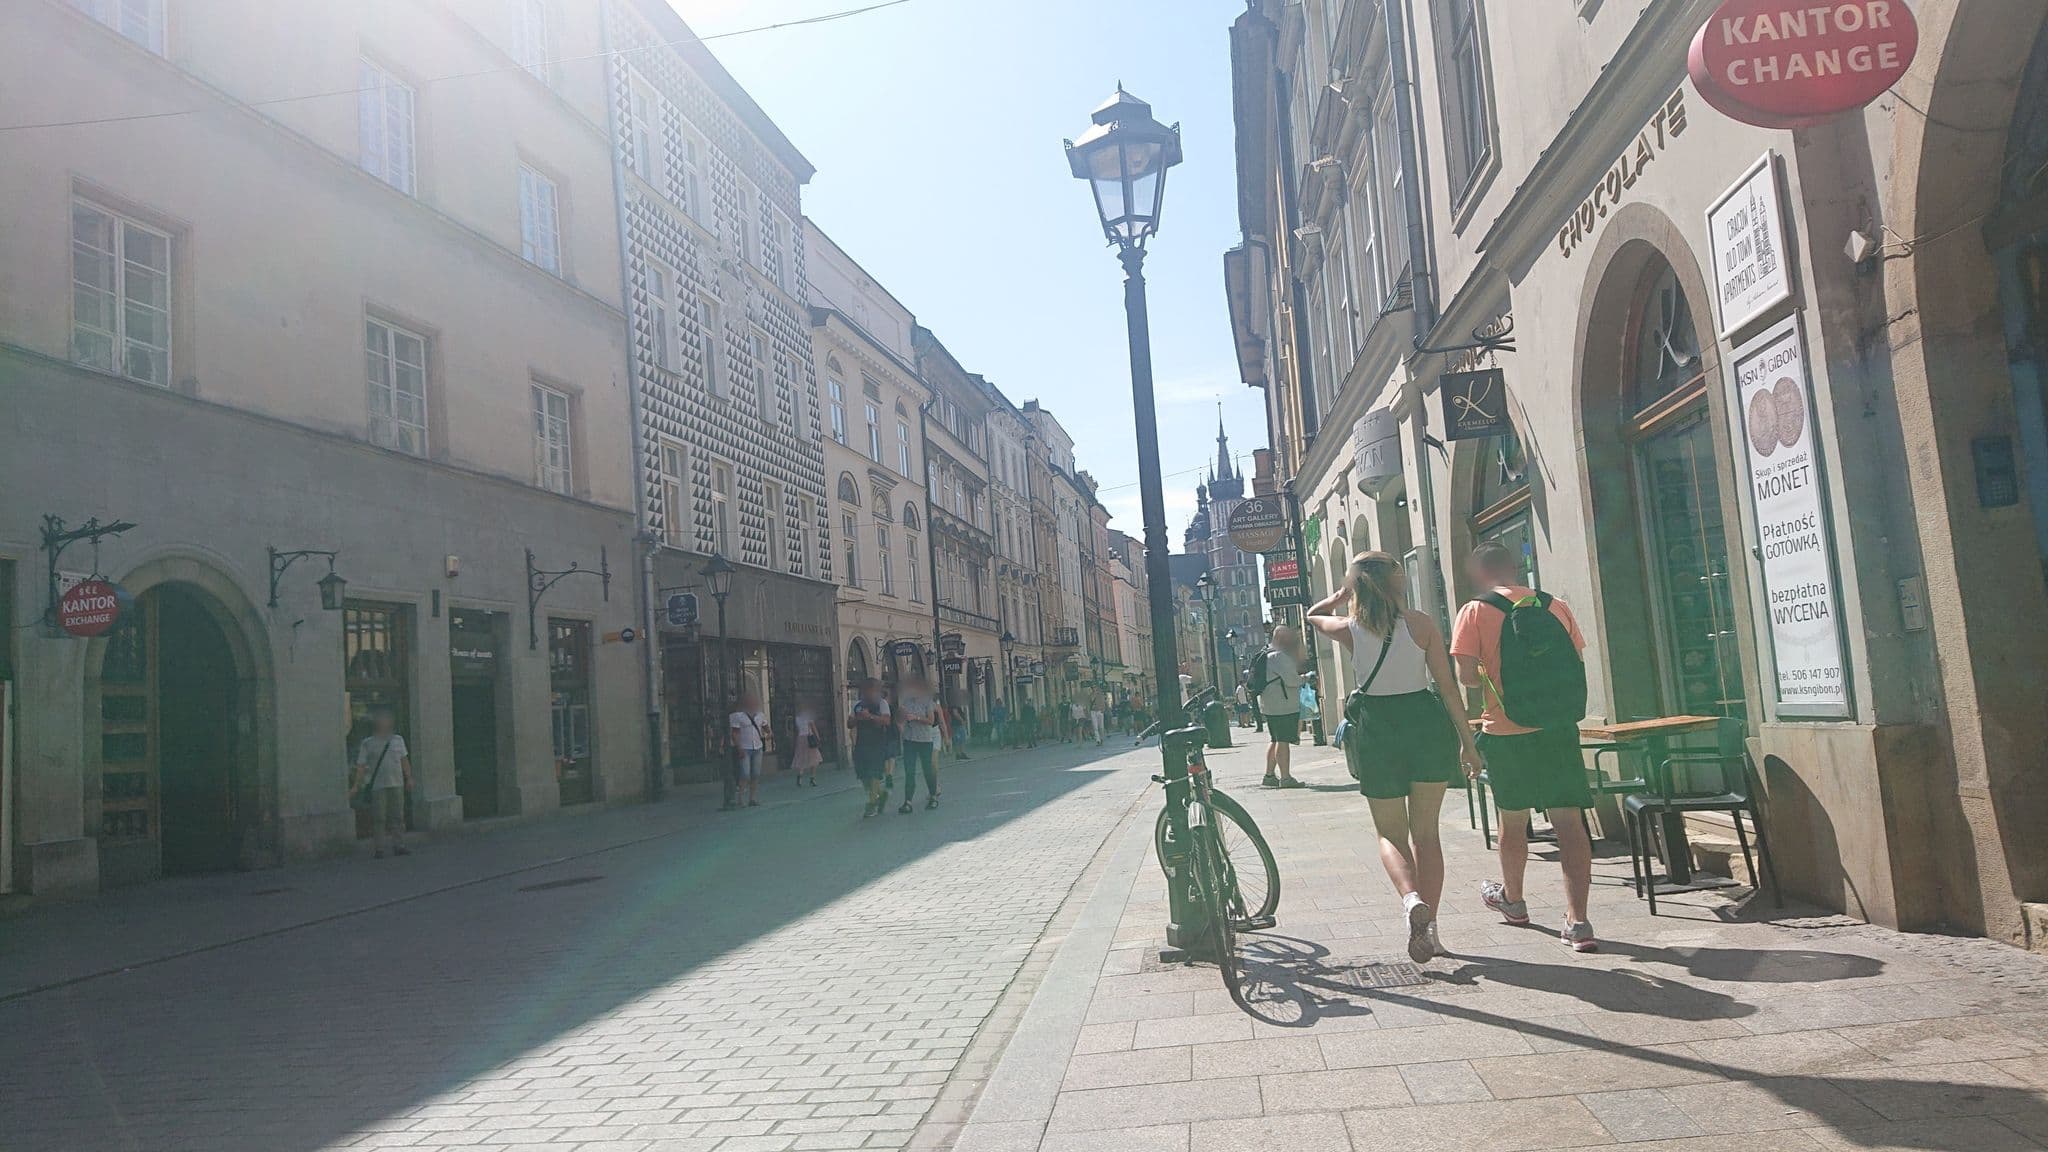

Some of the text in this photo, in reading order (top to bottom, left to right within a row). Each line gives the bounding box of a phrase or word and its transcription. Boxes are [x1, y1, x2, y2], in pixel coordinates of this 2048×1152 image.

[1722, 1, 1892, 46] KANTOR
[1726, 43, 1900, 86] CHANGE
[1559, 87, 1687, 258] CHOCOLATE
[1726, 205, 1749, 241] CRACOW
[1725, 234, 1753, 272] OLD TOWN
[1724, 263, 1756, 305] APARTMENTS
[1739, 345, 1797, 388] KSN GIBON
[1755, 466, 1771, 479] Skup
[1777, 452, 1808, 472] sprzedaż
[1757, 465, 1809, 501] MONET
[1232, 513, 1279, 524] ART GALLERY
[1245, 501, 1263, 514] 36
[1762, 511, 1816, 541] Płatność
[1765, 532, 1821, 560] GOTÓWKĄ
[1272, 563, 1298, 573] KANTO
[63, 596, 116, 614] KANTOR
[1271, 585, 1302, 599] TATT
[1771, 582, 1826, 604] bezpłatna
[65, 613, 112, 626] EXCHANGE
[1774, 601, 1829, 625] WYCENA
[1778, 667, 1840, 682] tel. 506 147 907
[1780, 684, 1842, 696] www.ksngibon.pl
